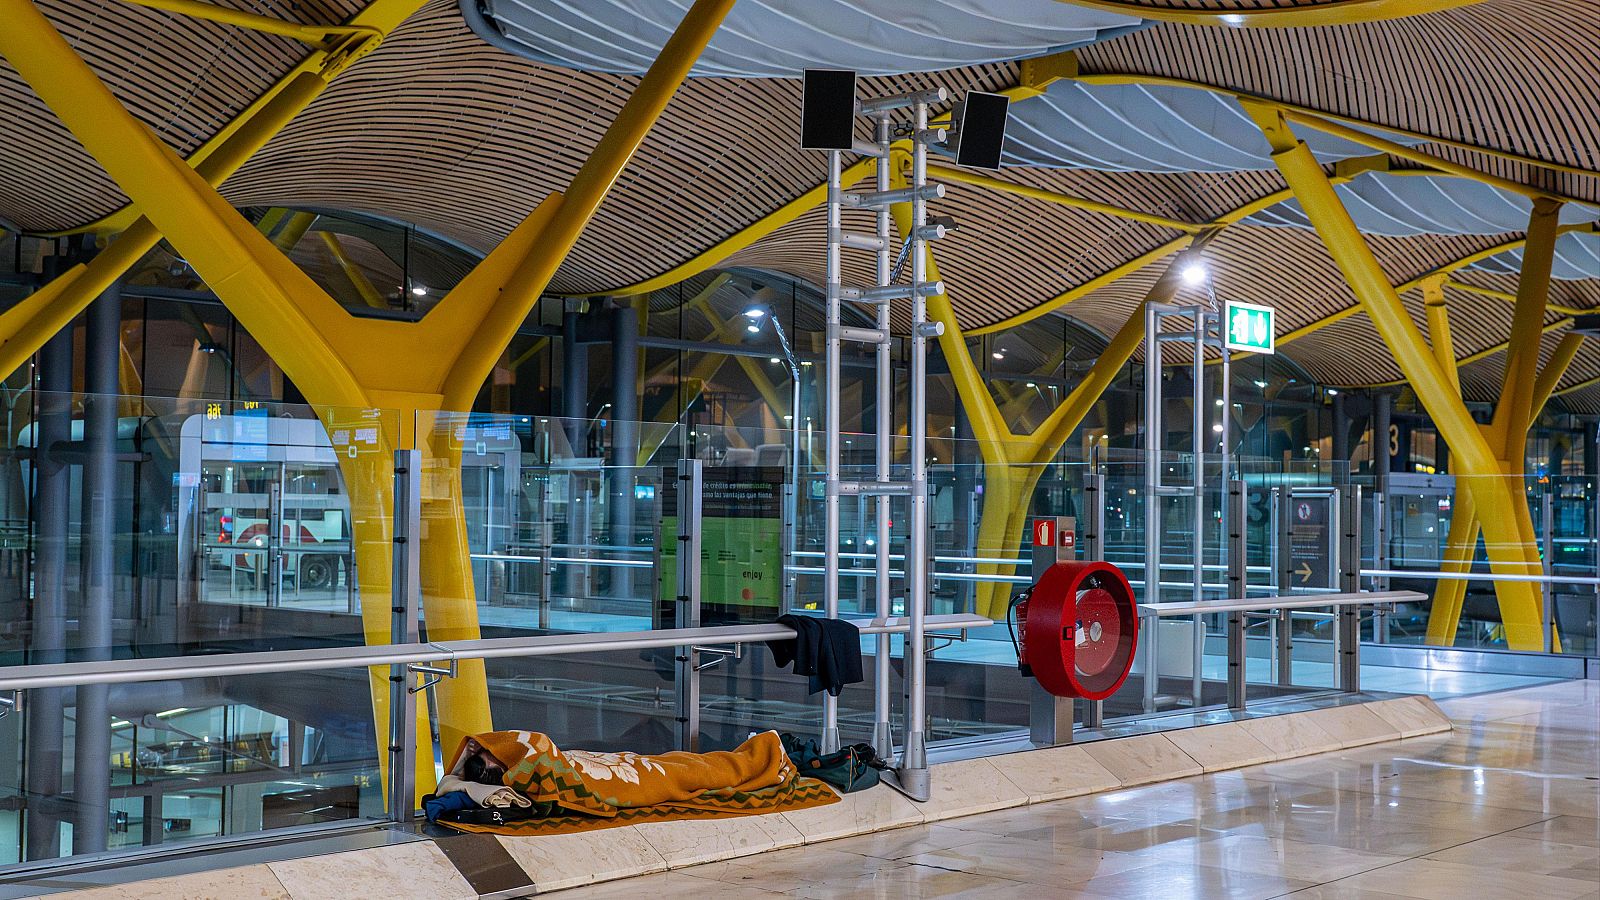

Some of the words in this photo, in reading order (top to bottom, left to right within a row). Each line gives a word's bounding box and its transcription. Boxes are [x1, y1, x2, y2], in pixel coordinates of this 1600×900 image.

[1389, 424, 1399, 456] 3
[710, 481, 728, 489] crédito
[722, 491, 745, 500] ventajas
[1247, 487, 1269, 527] 3
[742, 569, 763, 580] enjoy
